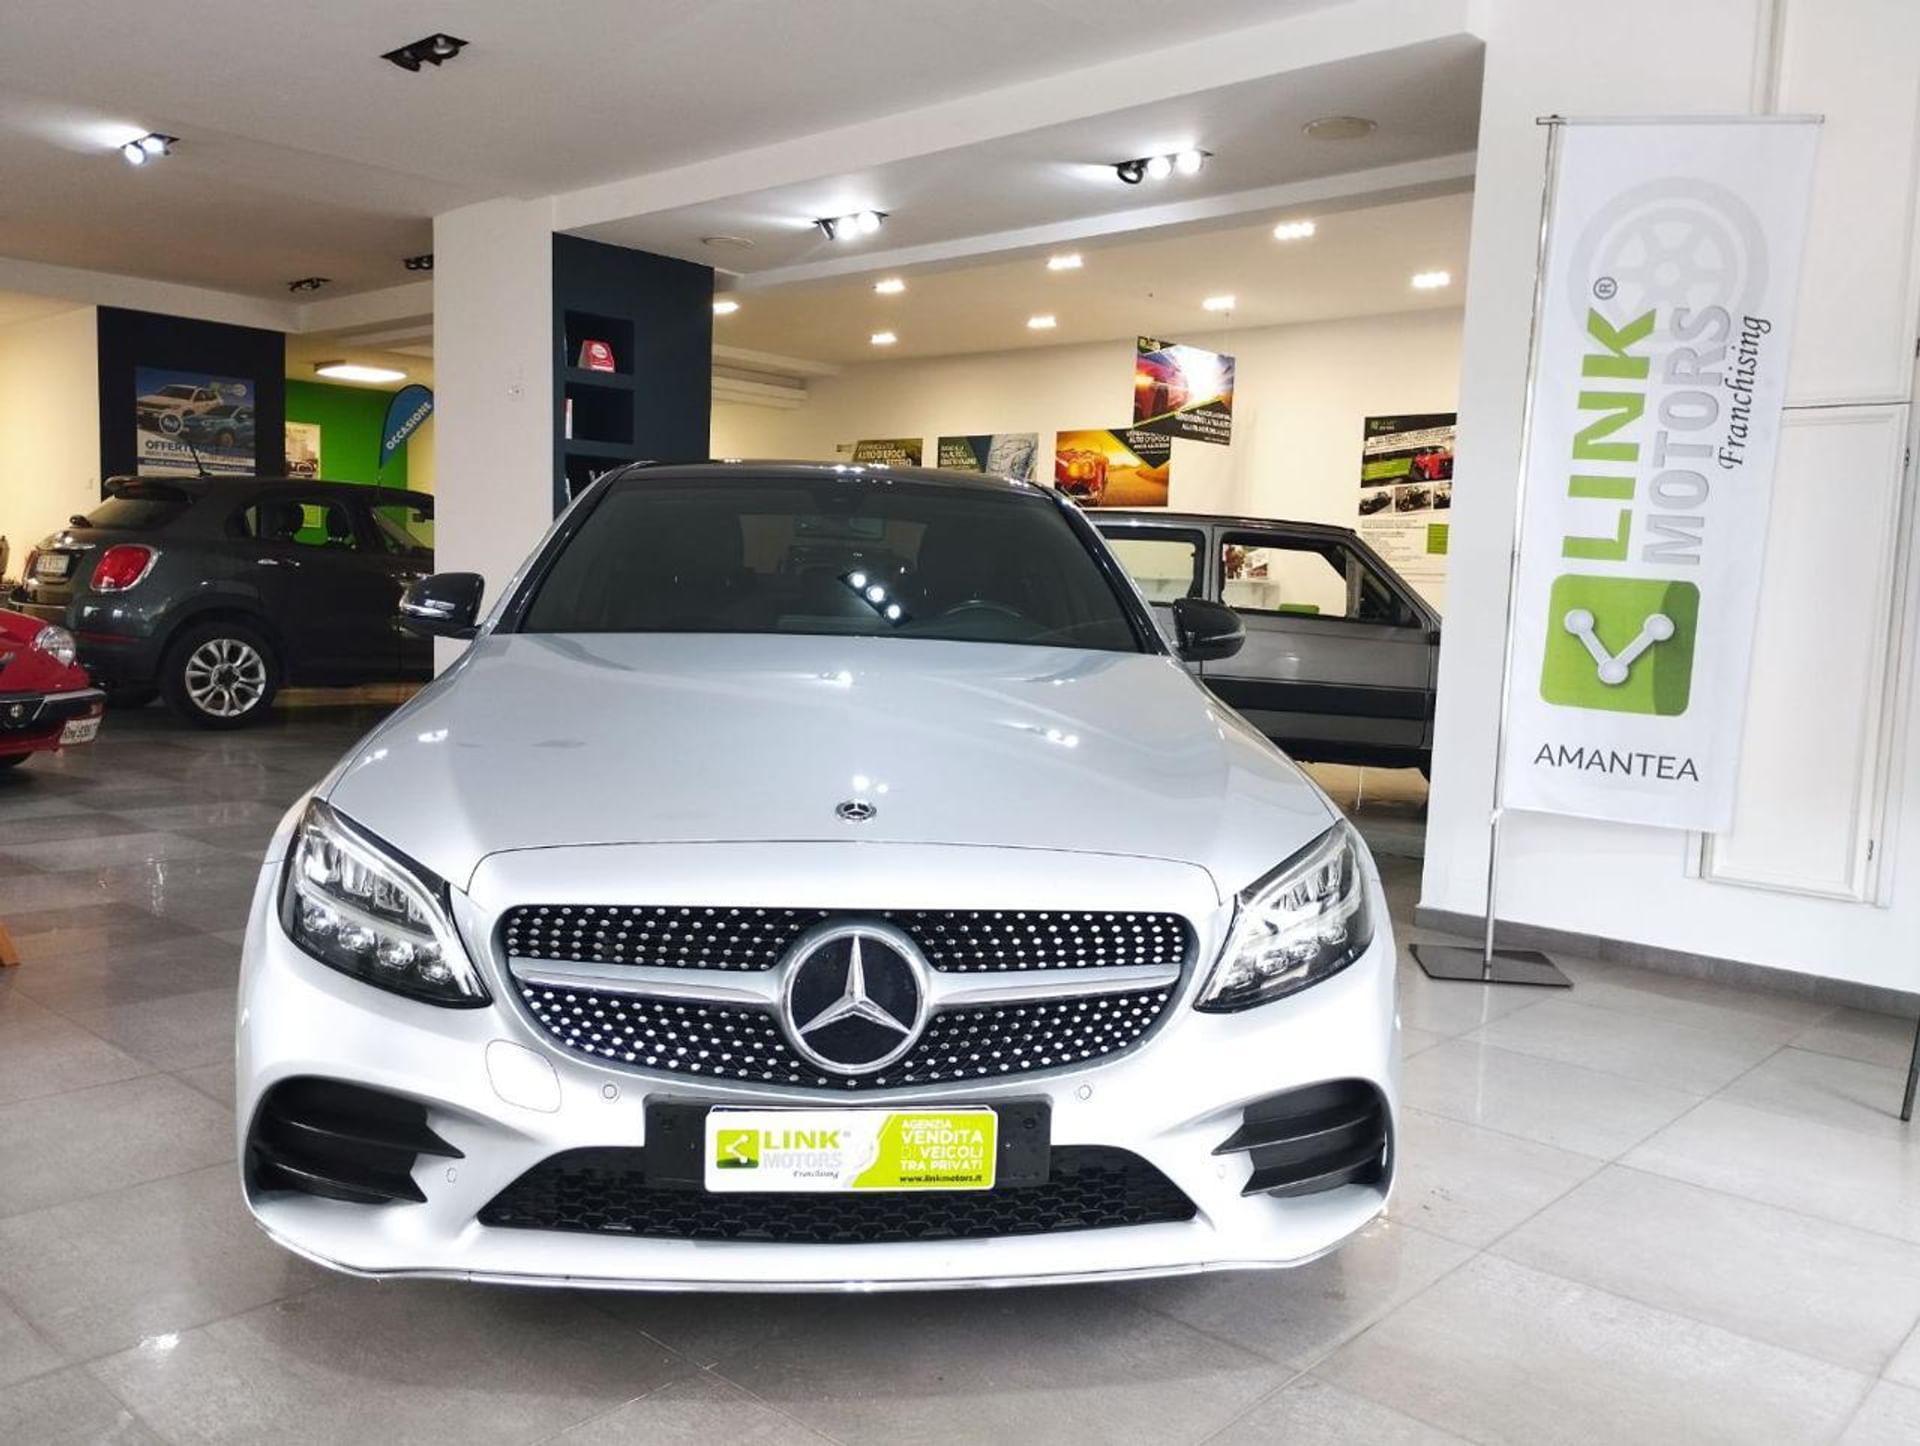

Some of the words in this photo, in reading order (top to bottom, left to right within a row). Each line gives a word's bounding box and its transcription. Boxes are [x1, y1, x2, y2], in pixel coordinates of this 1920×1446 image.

[1718, 315, 1772, 470] Franchising
[1642, 304, 1731, 566] MOTORS
[1534, 743, 1699, 782] AMANTEA
[902, 1129, 983, 1145] VENDITA
[763, 1151, 842, 1168] MOTORS
[921, 1145, 983, 1159] VEICOLI
[901, 1160, 926, 1170] TRA
[930, 1159, 983, 1170] PRIVATI
